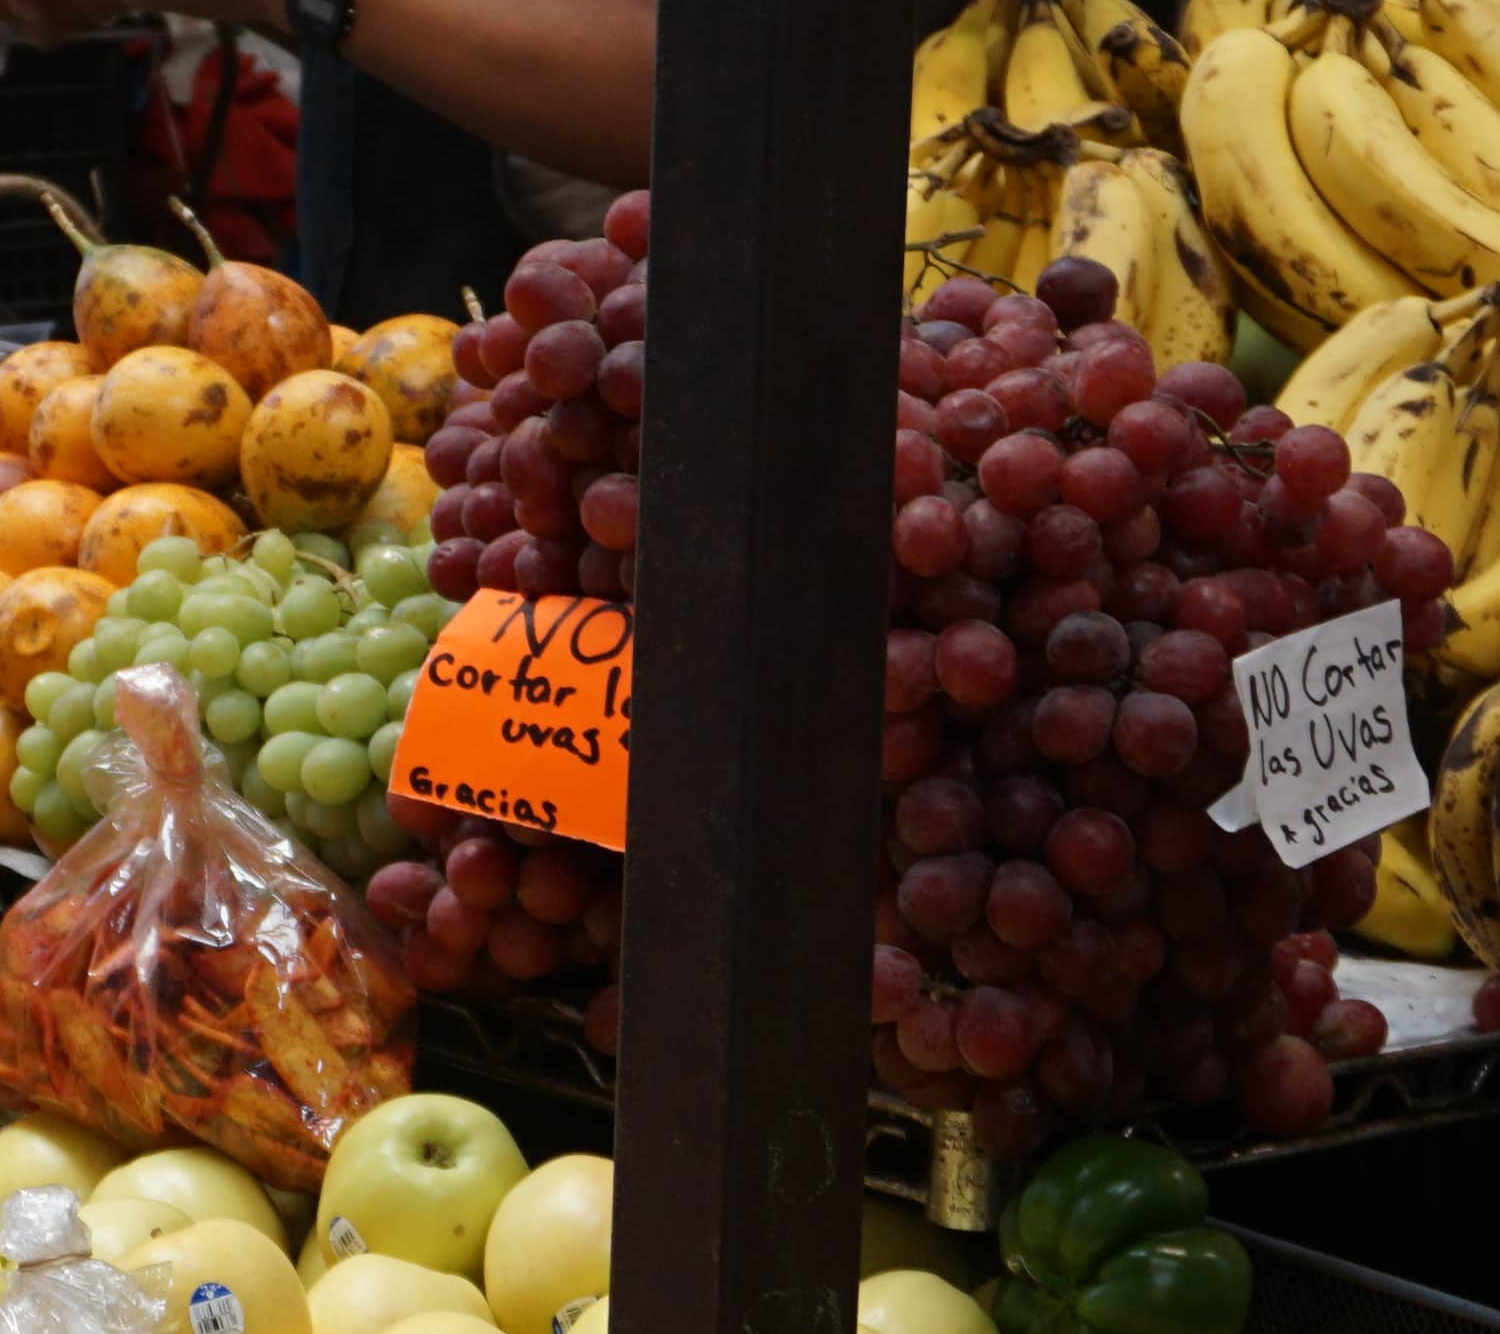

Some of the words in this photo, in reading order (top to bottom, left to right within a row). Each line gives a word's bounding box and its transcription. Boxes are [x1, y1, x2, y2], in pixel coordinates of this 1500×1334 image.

[490, 595, 633, 665] NO
[428, 653, 577, 707] Cortar
[1249, 663, 1291, 730] NO
[1301, 636, 1402, 707] Cortar
[501, 717, 601, 765] uvas
[1259, 738, 1303, 787] las
[1308, 703, 1394, 770] Uvas
[408, 765, 558, 831] Gracias
